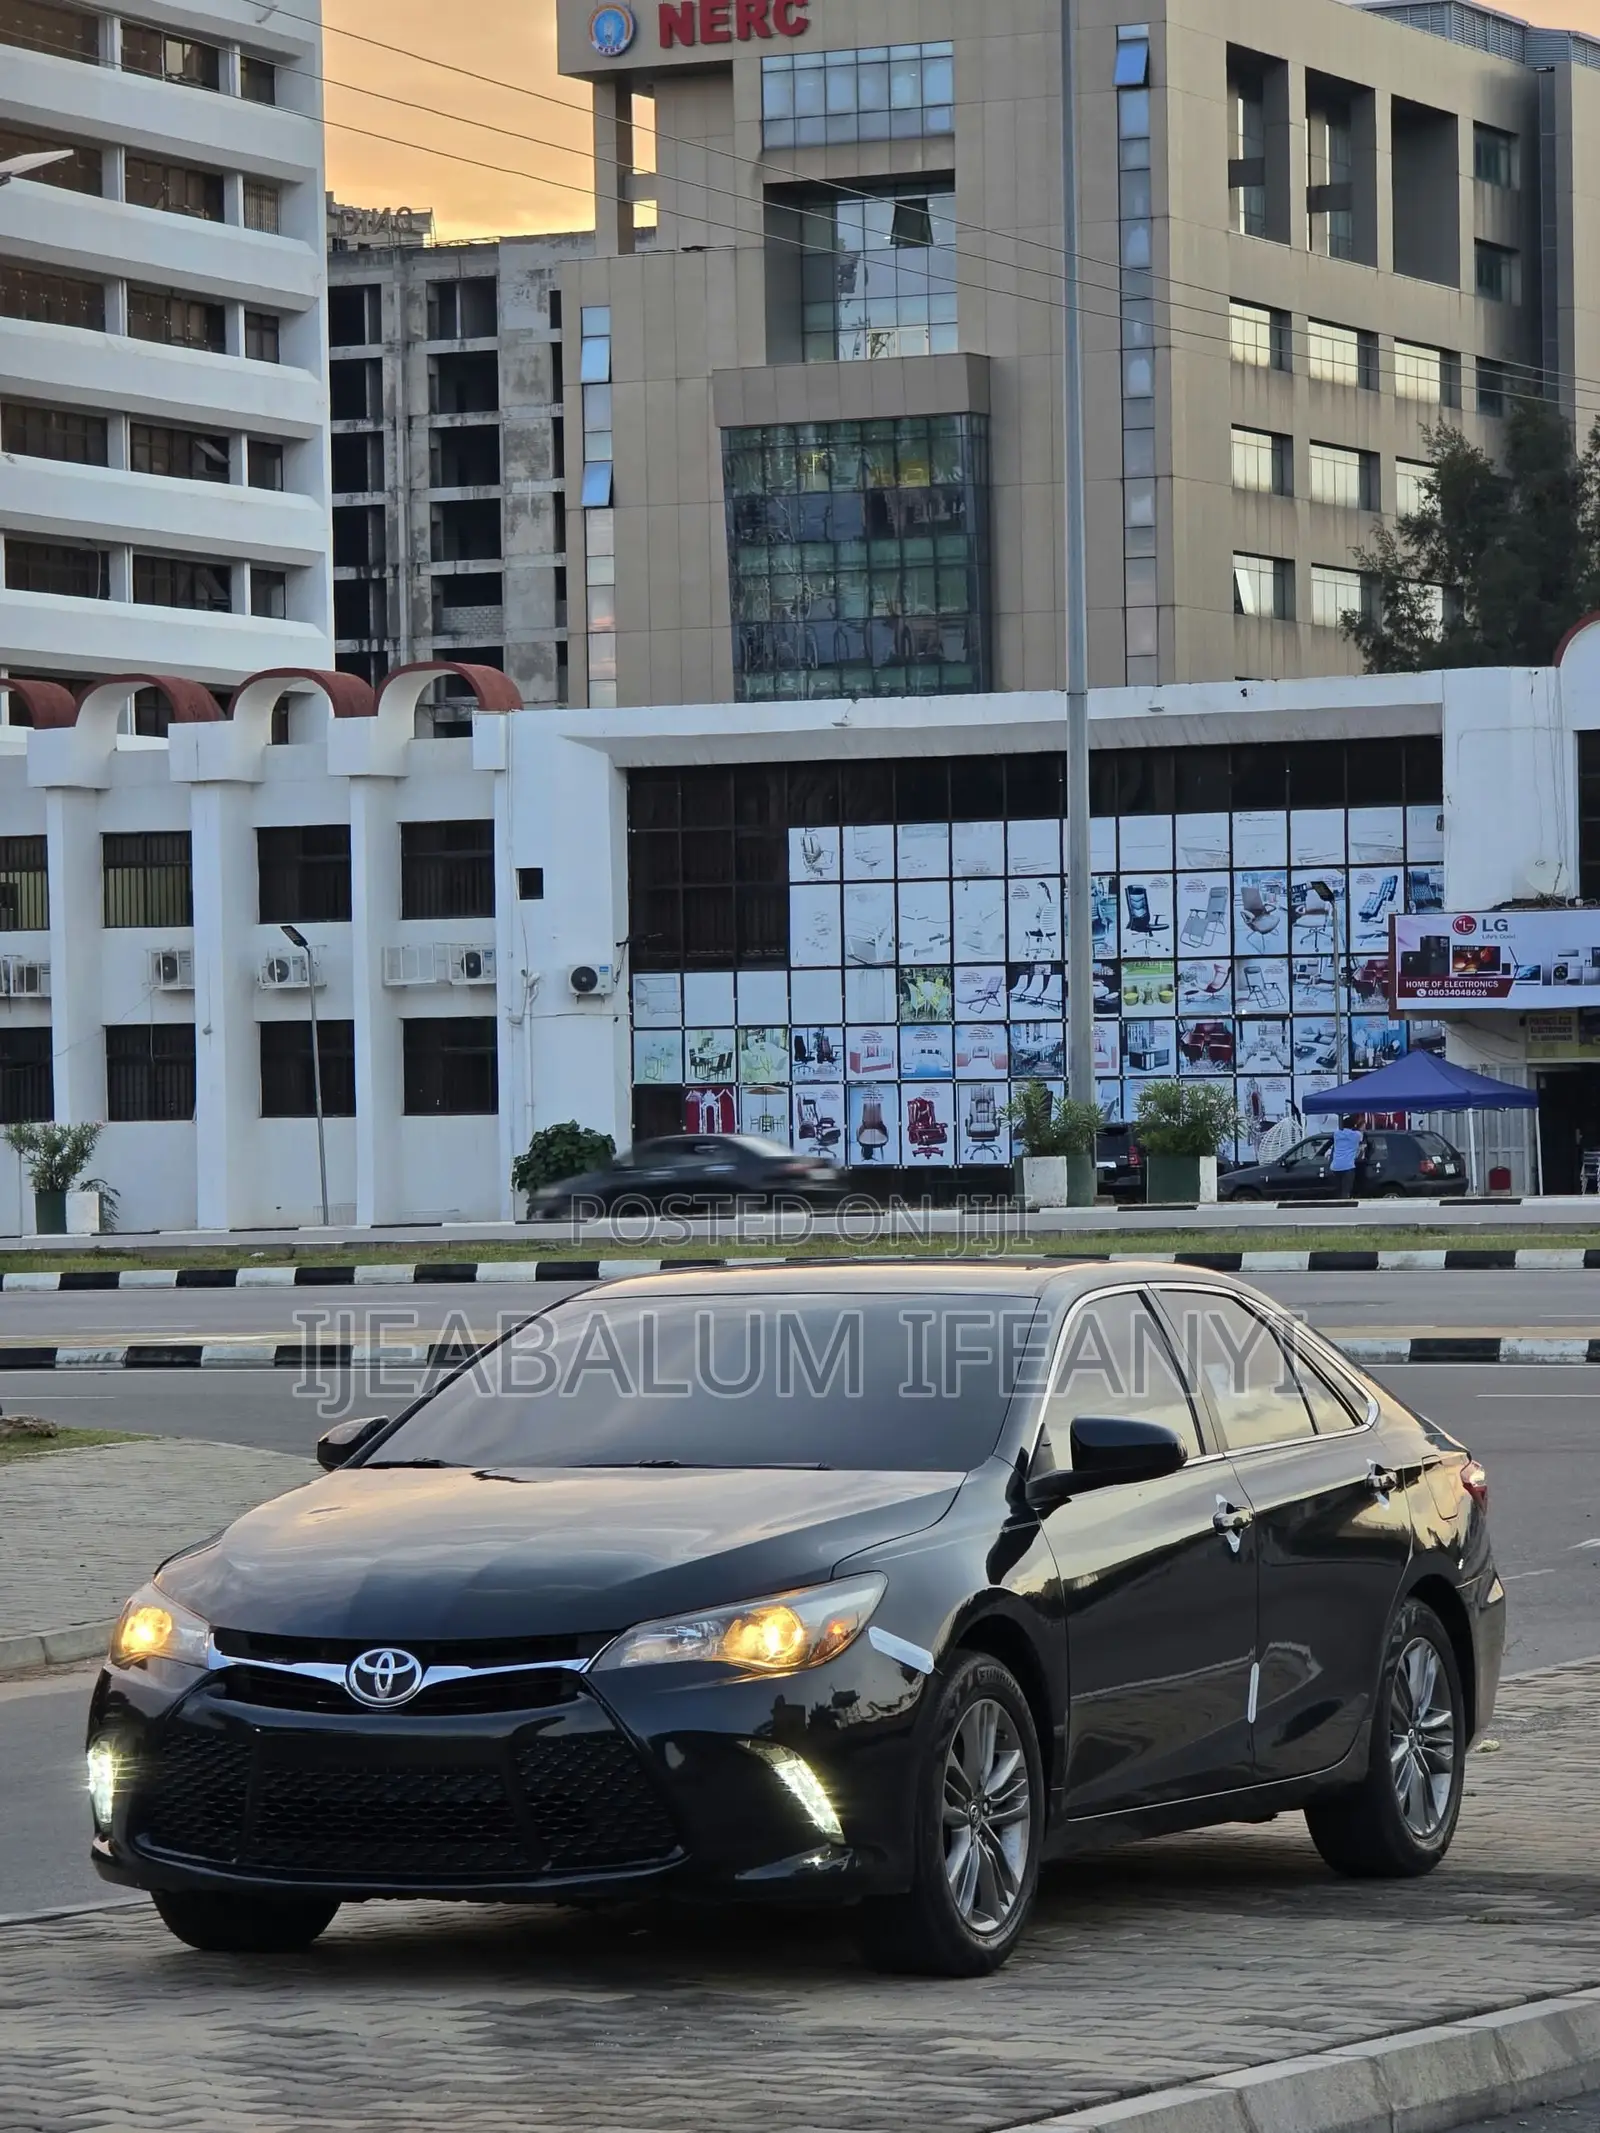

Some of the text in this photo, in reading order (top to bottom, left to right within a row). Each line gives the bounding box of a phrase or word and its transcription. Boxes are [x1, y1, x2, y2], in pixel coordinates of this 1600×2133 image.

[658, 0, 810, 49] NERC
[1482, 918, 1509, 932] LG
[1405, 980, 1499, 988] HOME OF ELECTRONICS
[1428, 988, 1488, 996] 08034048626
